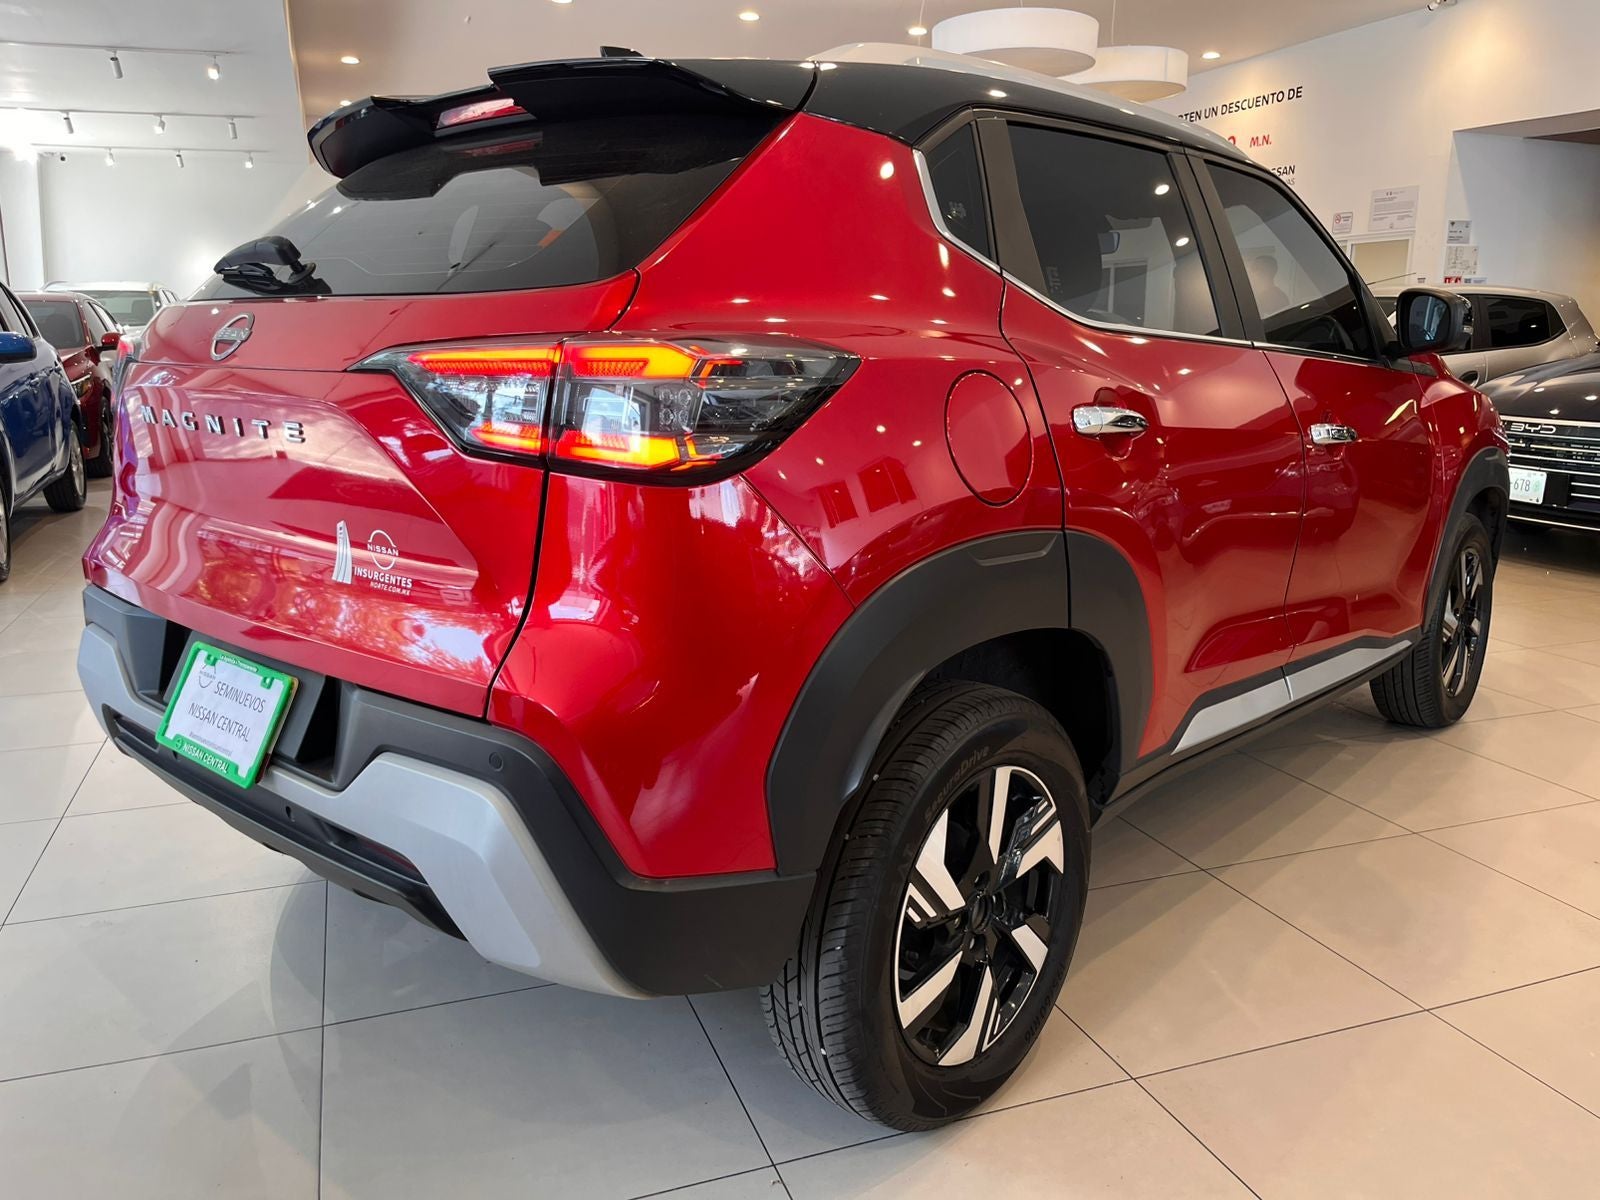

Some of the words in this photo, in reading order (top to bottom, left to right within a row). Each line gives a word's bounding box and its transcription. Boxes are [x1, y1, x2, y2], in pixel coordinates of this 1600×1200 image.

[1178, 110, 1202, 122] TEN
[1204, 106, 1218, 119] UN
[1220, 91, 1285, 115] DESCUENTO
[1287, 86, 1303, 100] DE
[1249, 134, 1272, 147] M.N.
[140, 405, 306, 443] MAGNITE
[1510, 422, 1556, 434] BYD
[367, 543, 399, 556] NISSAN
[354, 566, 413, 588] INSURGENTES
[214, 681, 266, 713] SEMINUEVOS
[188, 702, 219, 727] NISSAN
[216, 715, 251, 742] CENTRAL
[183, 742, 204, 760] NISSAN
[203, 753, 229, 774] CENTRAL
